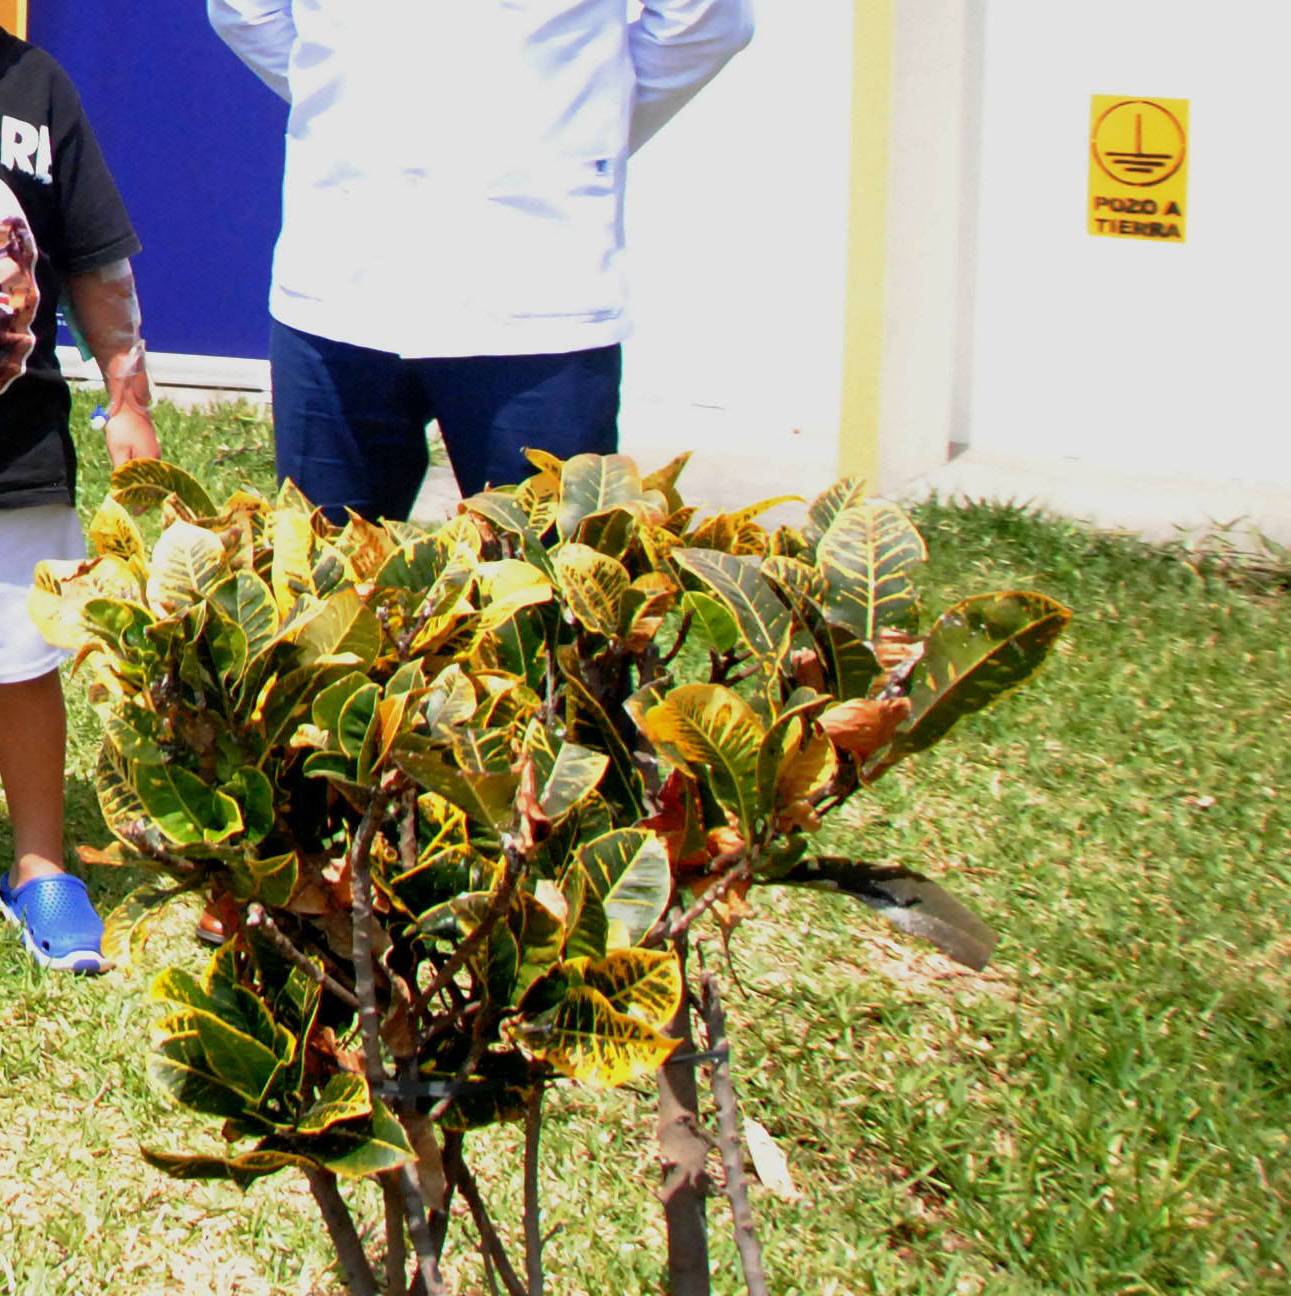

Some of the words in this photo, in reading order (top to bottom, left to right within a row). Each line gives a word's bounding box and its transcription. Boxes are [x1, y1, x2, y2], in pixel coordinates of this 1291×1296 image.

[1093, 196, 1157, 215] POZO
[1163, 200, 1182, 216] A
[1094, 218, 1182, 238] TIERRA
